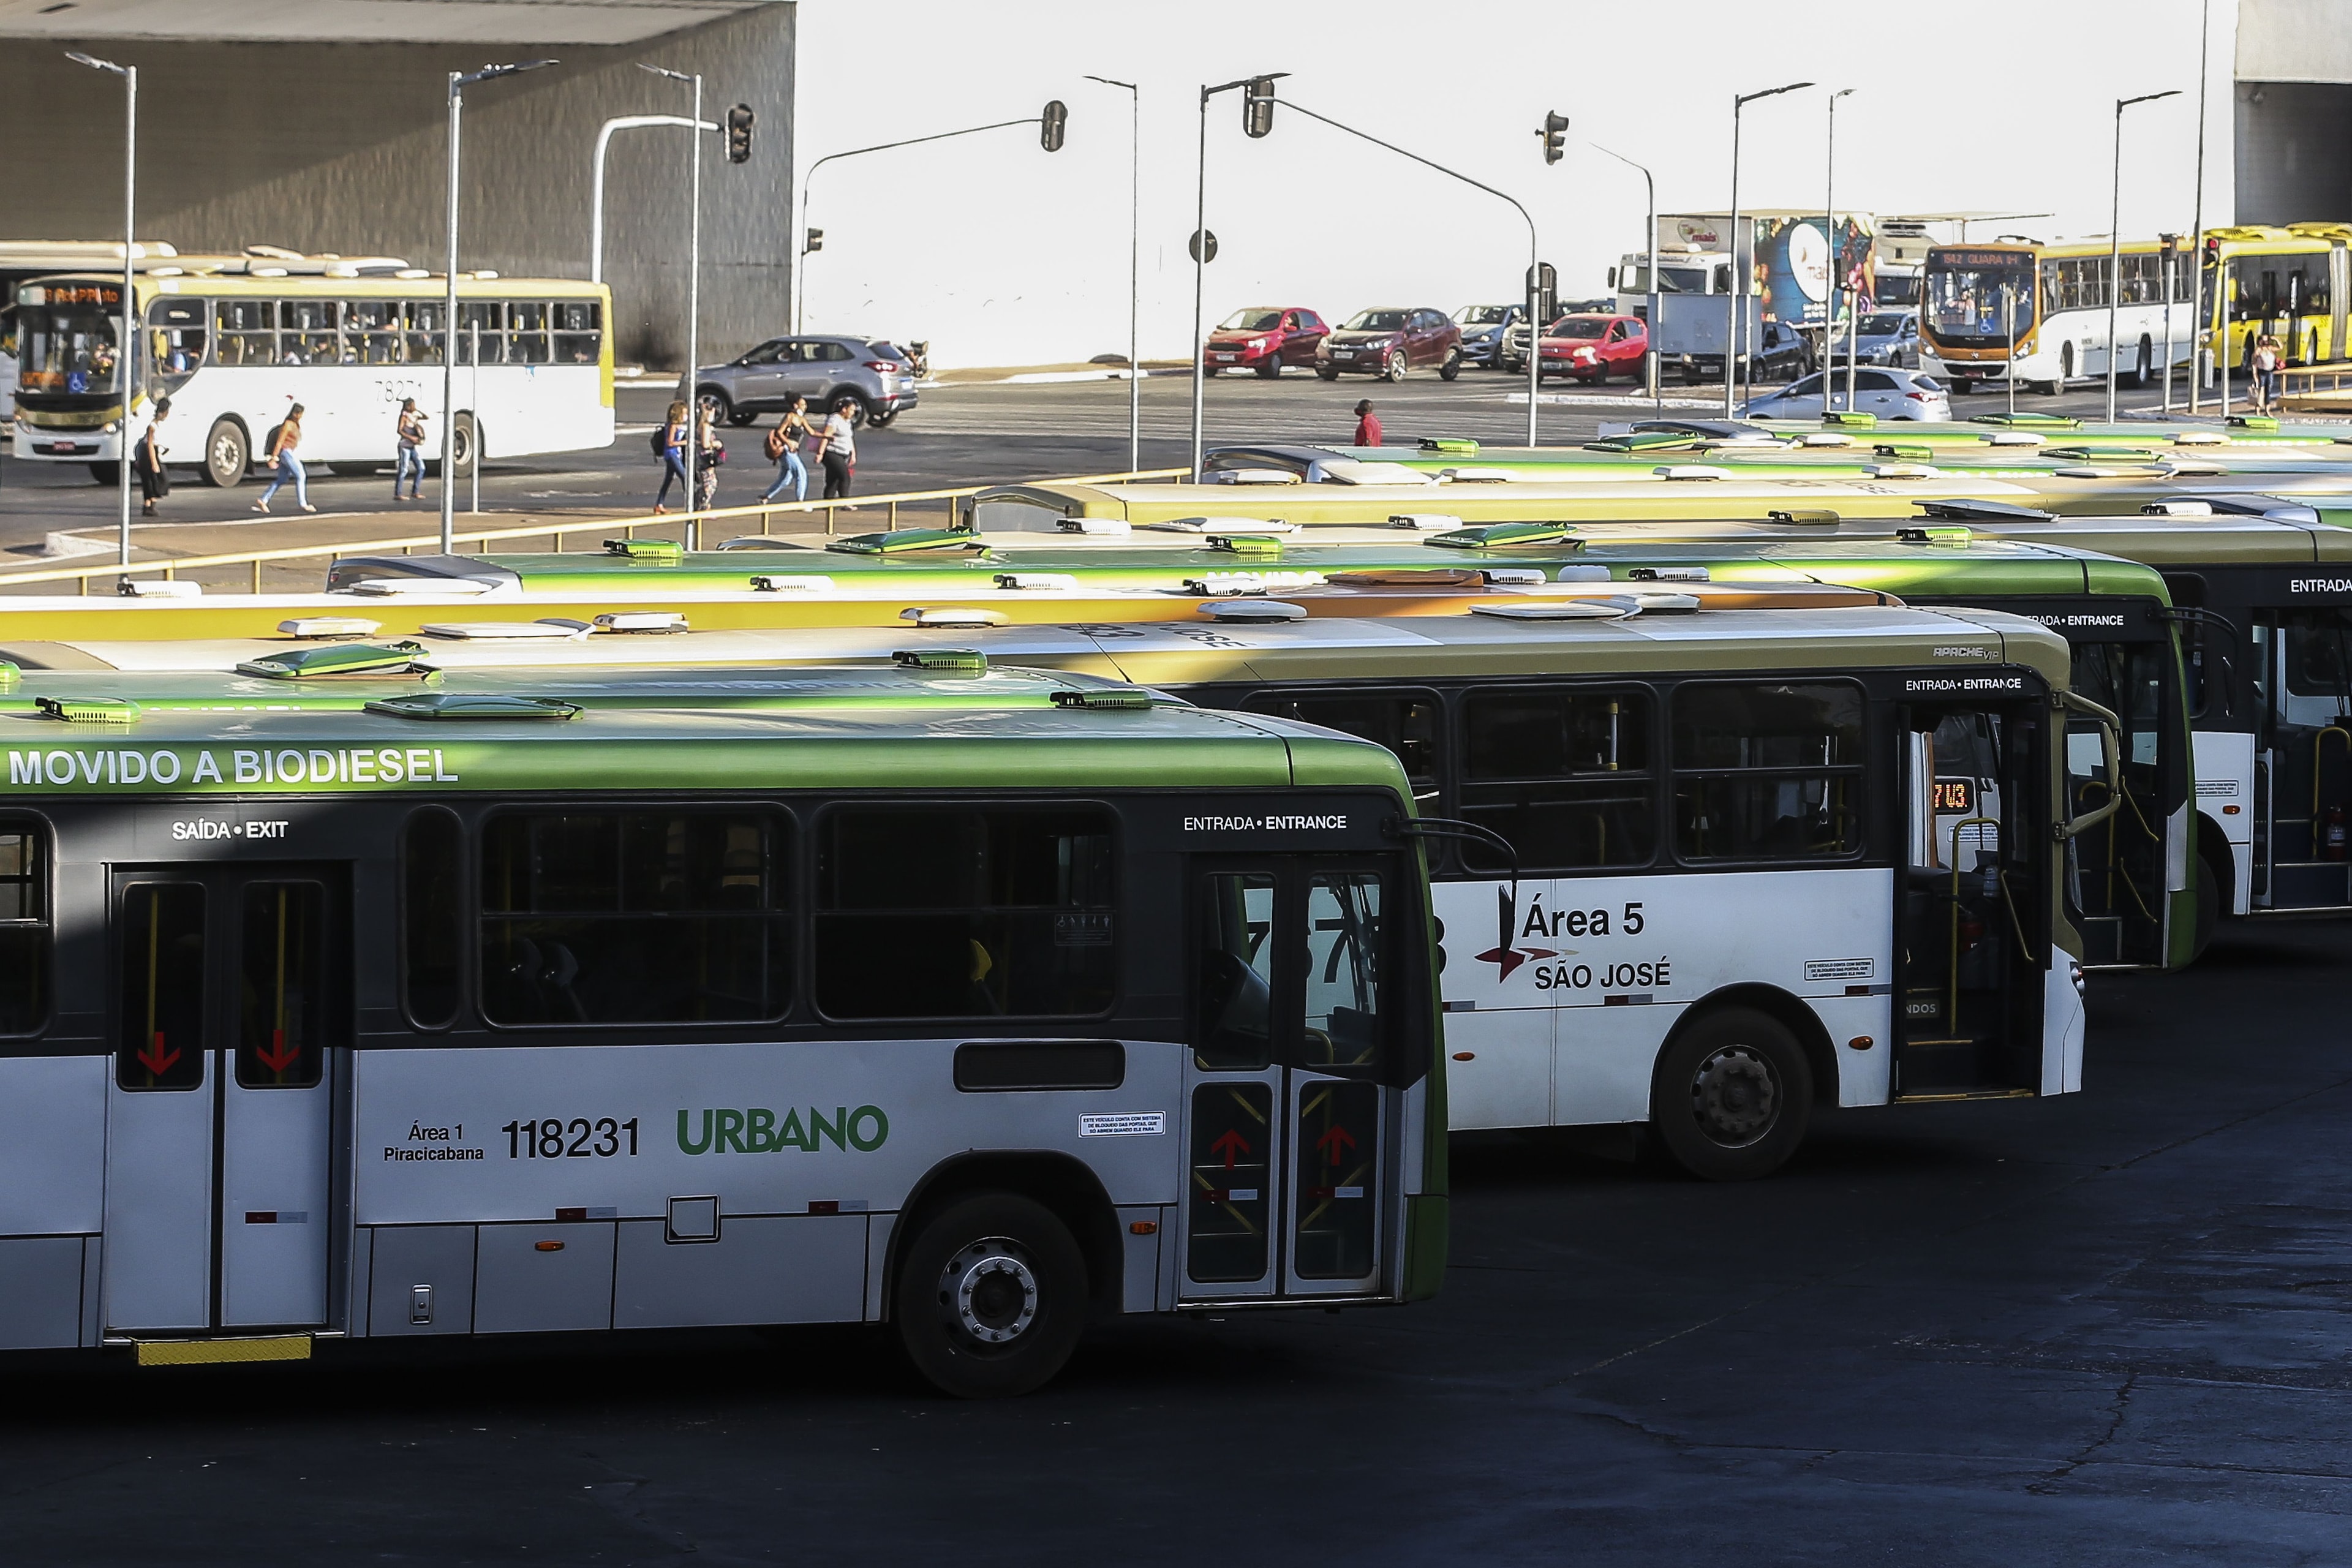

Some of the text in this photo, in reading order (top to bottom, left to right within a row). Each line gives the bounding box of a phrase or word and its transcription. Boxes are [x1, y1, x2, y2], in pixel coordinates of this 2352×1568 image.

[2291, 579, 2352, 592] ENTRADA
[2067, 615, 2124, 625] ENTRANCE
[1933, 647, 1983, 657] APACHE
[1905, 678, 2021, 691] ENTRADA ENTRANCE
[8, 748, 459, 785] MOVIDO A BIODIESEL
[172, 817, 288, 841] SAÍDA EXIT
[1183, 815, 1347, 831] ENTRADA ENTRANCE
[1521, 893, 1645, 938] Área 5
[1534, 956, 1671, 990] SÃO JOSÉ
[408, 1120, 464, 1141] Área 1
[501, 1117, 639, 1159] 118231
[677, 1104, 889, 1156] URBANO
[383, 1146, 484, 1161] Piracicabana
